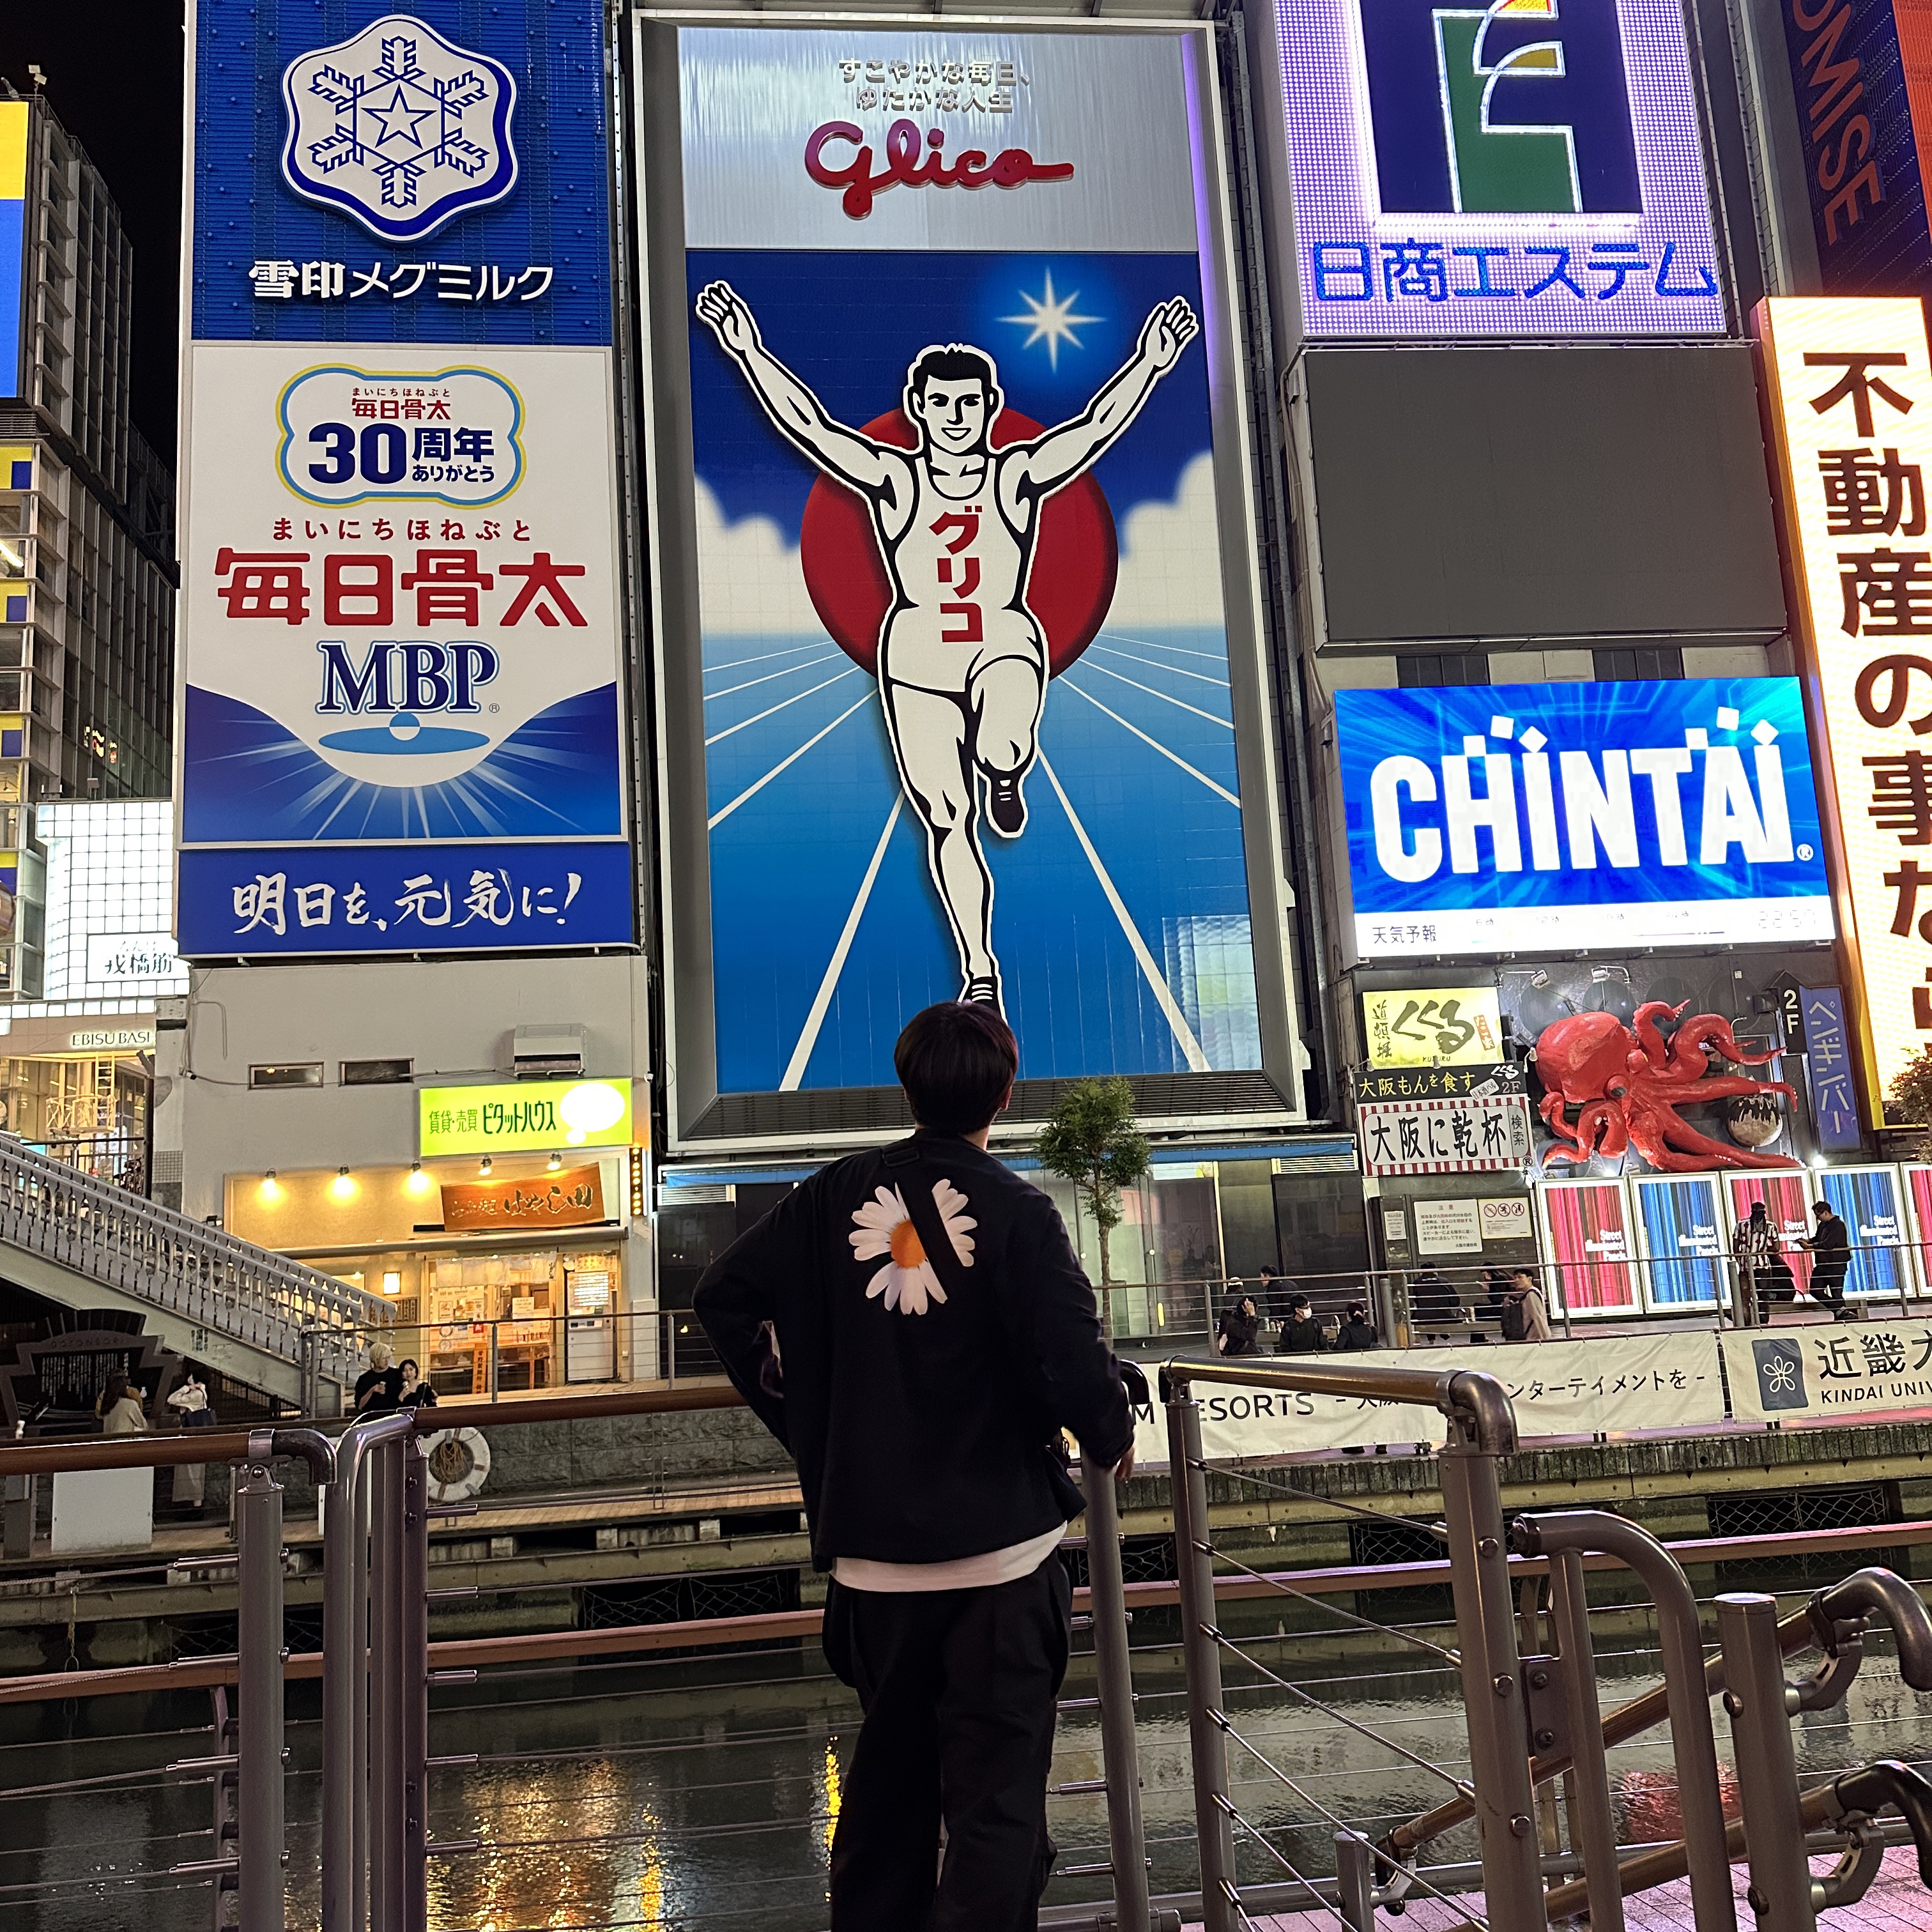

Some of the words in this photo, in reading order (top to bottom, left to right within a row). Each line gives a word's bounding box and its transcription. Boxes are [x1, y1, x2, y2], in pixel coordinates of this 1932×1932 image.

[838, 58, 1031, 87] すこやかな毎日、
[856, 86, 1014, 113] ゆたかな人生
[804, 118, 1075, 220] Glico
[249, 259, 555, 303] 雪印メグミルク
[1312, 238, 1719, 303] 日商エステム
[352, 387, 450, 397] まいにちほねぶと
[352, 398, 451, 420] 毎日骨太
[411, 465, 494, 483] ありがとう
[273, 518, 532, 541] まいにちほねぶと
[215, 548, 588, 627] 毎日骨太
[928, 505, 983, 643] グリコ
[314, 640, 500, 716] MBP
[1803, 352, 1932, 1057] 不動産の事
[1372, 924, 1437, 944] 天気予報
[72, 1032, 115, 1046] EBISU
[1372, 999, 1392, 1060] 道頓堀
[1391, 999, 1475, 1054] くくる
[1491, 1065, 1519, 1079] くくる
[1808, 999, 1851, 1134] ペンギンバー
[1359, 1071, 1475, 1098] 大阪もんを食す
[1501, 1080, 1521, 1094] 2F
[429, 1108, 478, 1134] 賃貸・売買
[482, 1100, 557, 1135] ピタットハウス
[1510, 1114, 1525, 1147] 検索
[1370, 1108, 1507, 1162] 大阪に乾杯
[1199, 1392, 1315, 1422] ESORTS
[1821, 1385, 1883, 1404] KINDAI
